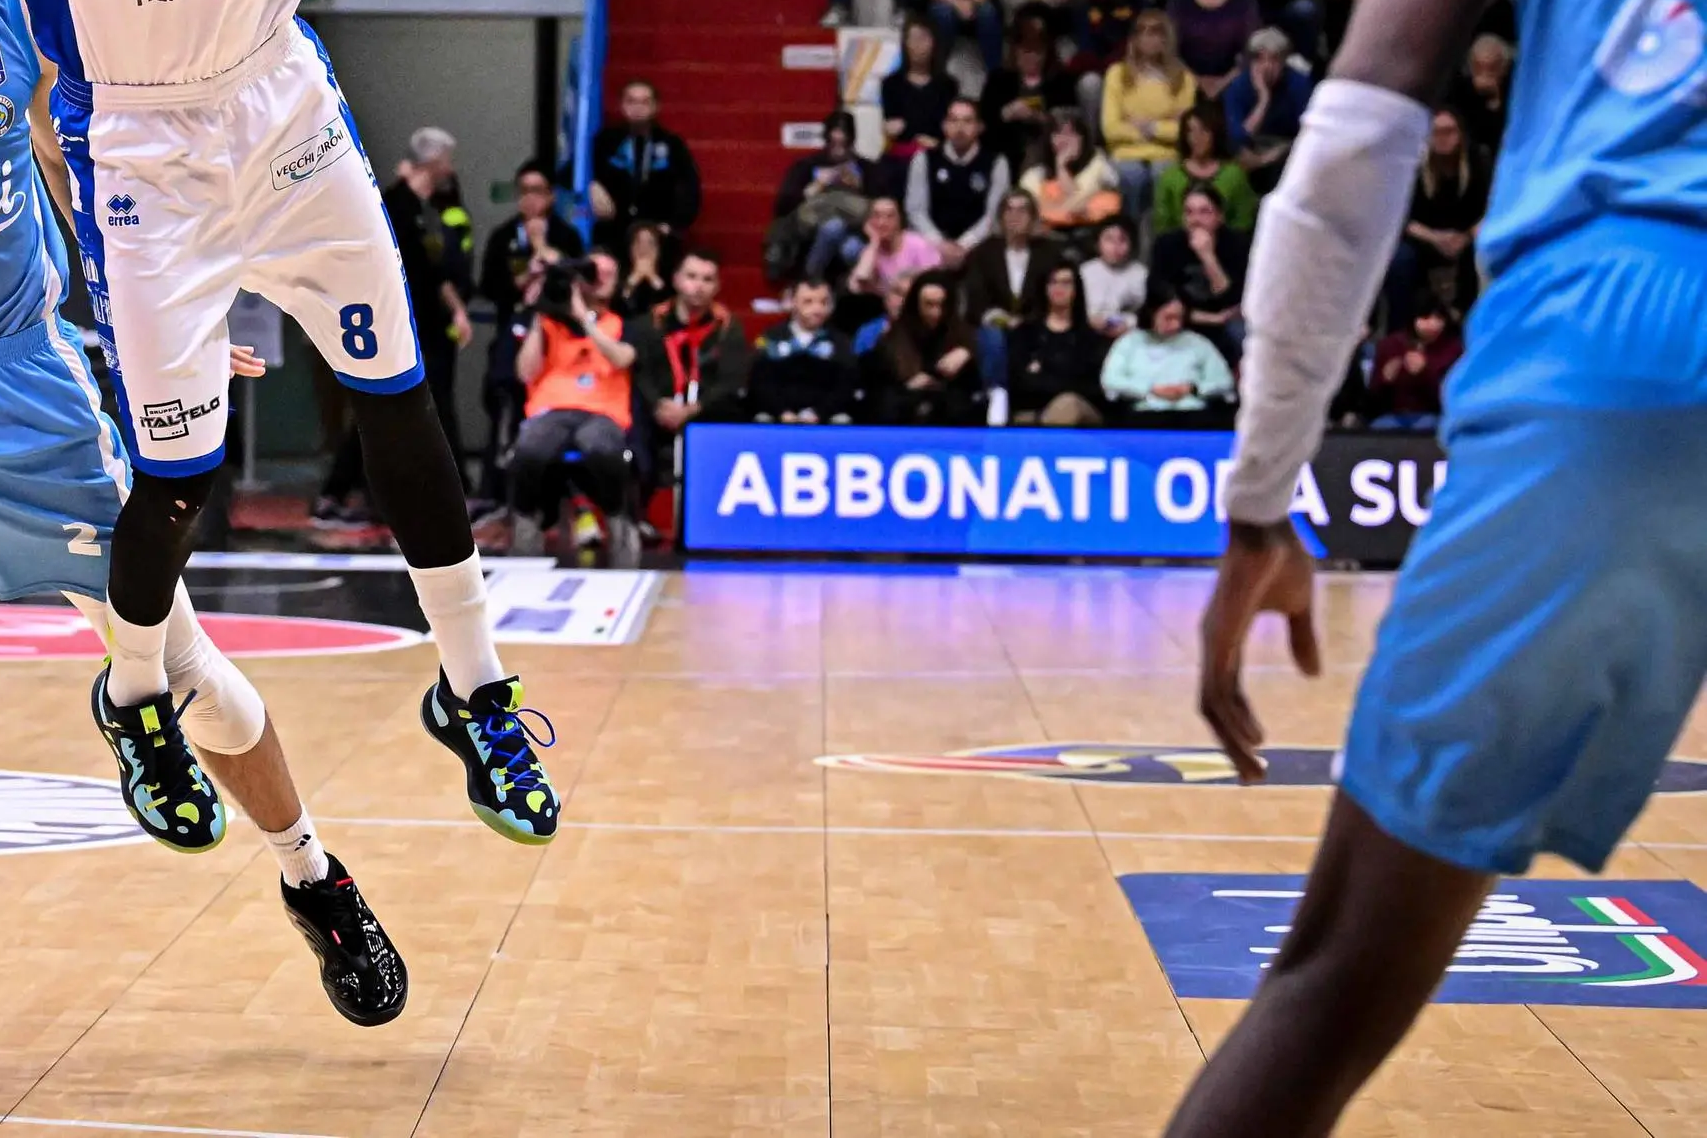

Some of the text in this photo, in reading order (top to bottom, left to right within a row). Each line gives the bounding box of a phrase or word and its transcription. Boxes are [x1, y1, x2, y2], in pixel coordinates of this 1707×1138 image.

[276, 152, 314, 178] VECCHI
[108, 212, 140, 226] errea
[339, 303, 379, 360] 8
[717, 452, 1129, 521] ABBONATI
[62, 522, 102, 557] 2
